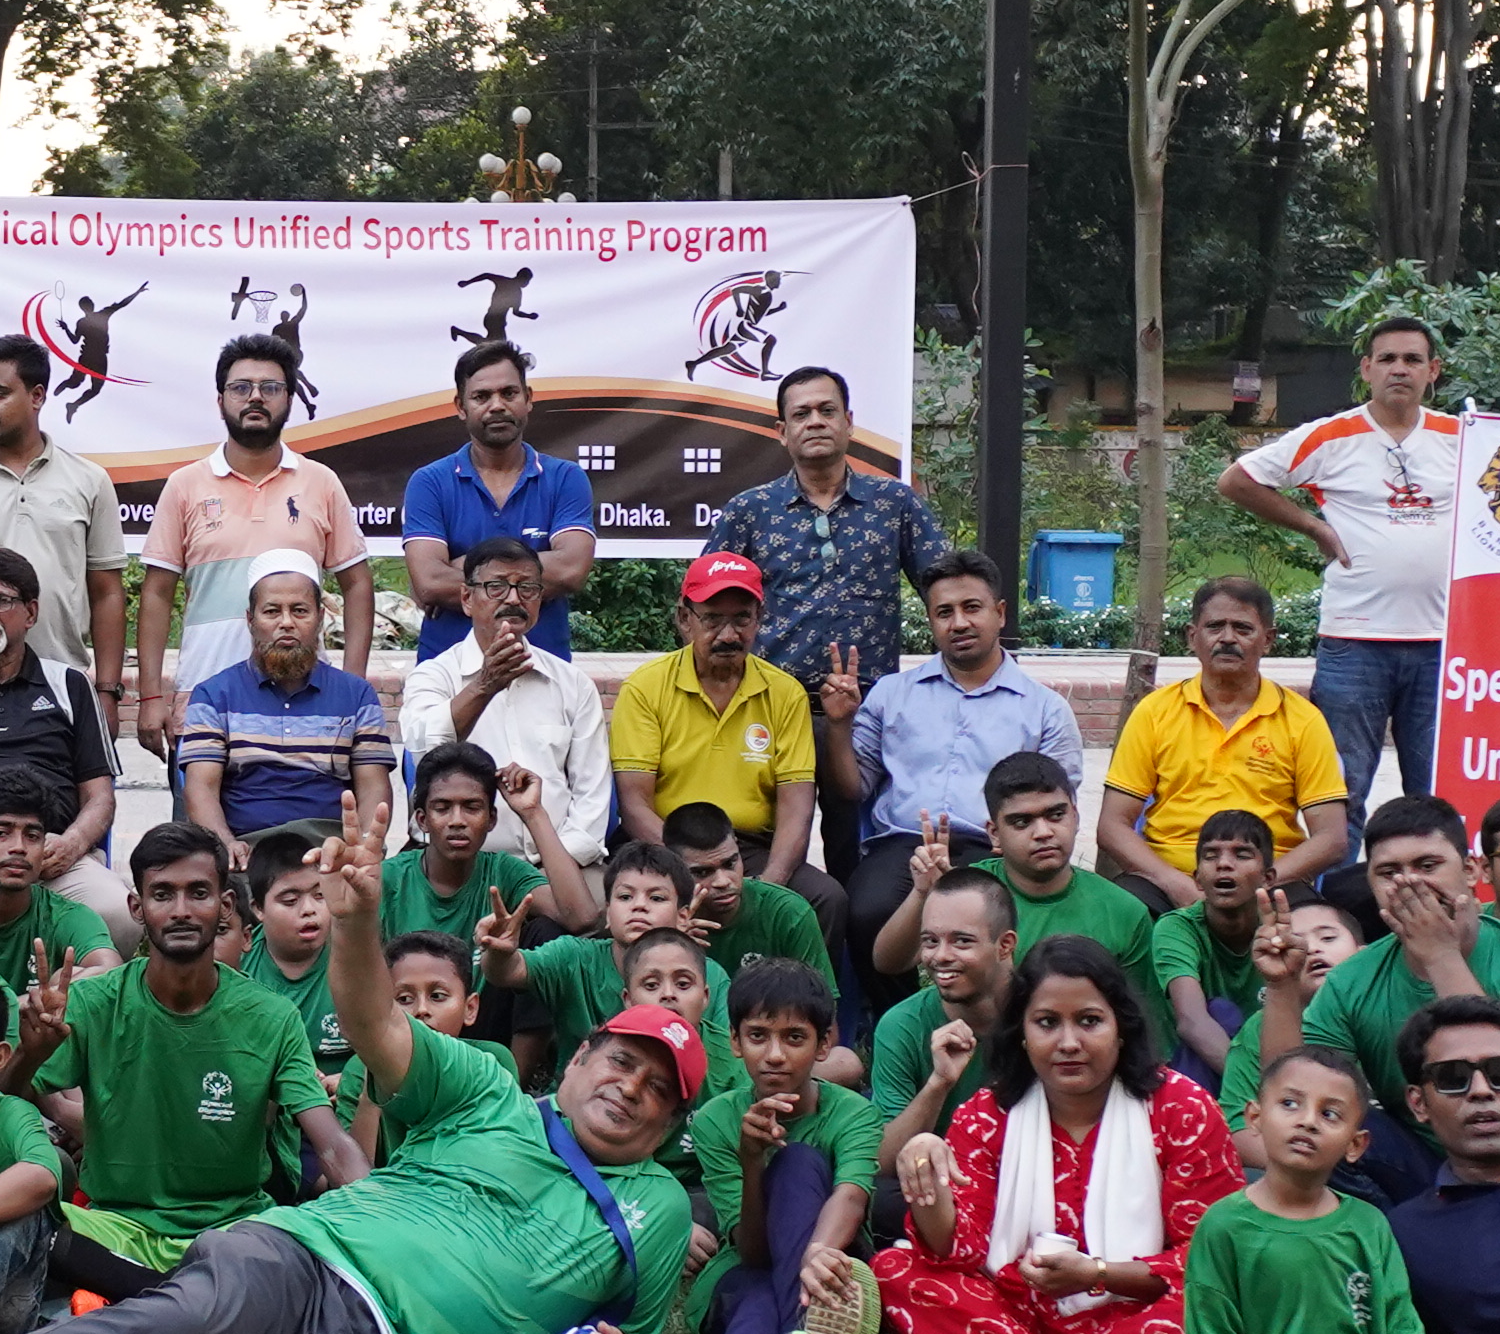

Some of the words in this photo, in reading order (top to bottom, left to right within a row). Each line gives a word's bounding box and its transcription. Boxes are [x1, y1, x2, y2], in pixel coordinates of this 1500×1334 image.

[69, 213, 222, 256] Olympics
[235, 215, 351, 249] Unified
[363, 217, 470, 258] Sports
[480, 217, 616, 262] Training
[627, 219, 767, 262] Program
[600, 502, 671, 527] Dhaka.
[695, 503, 722, 527] Da
